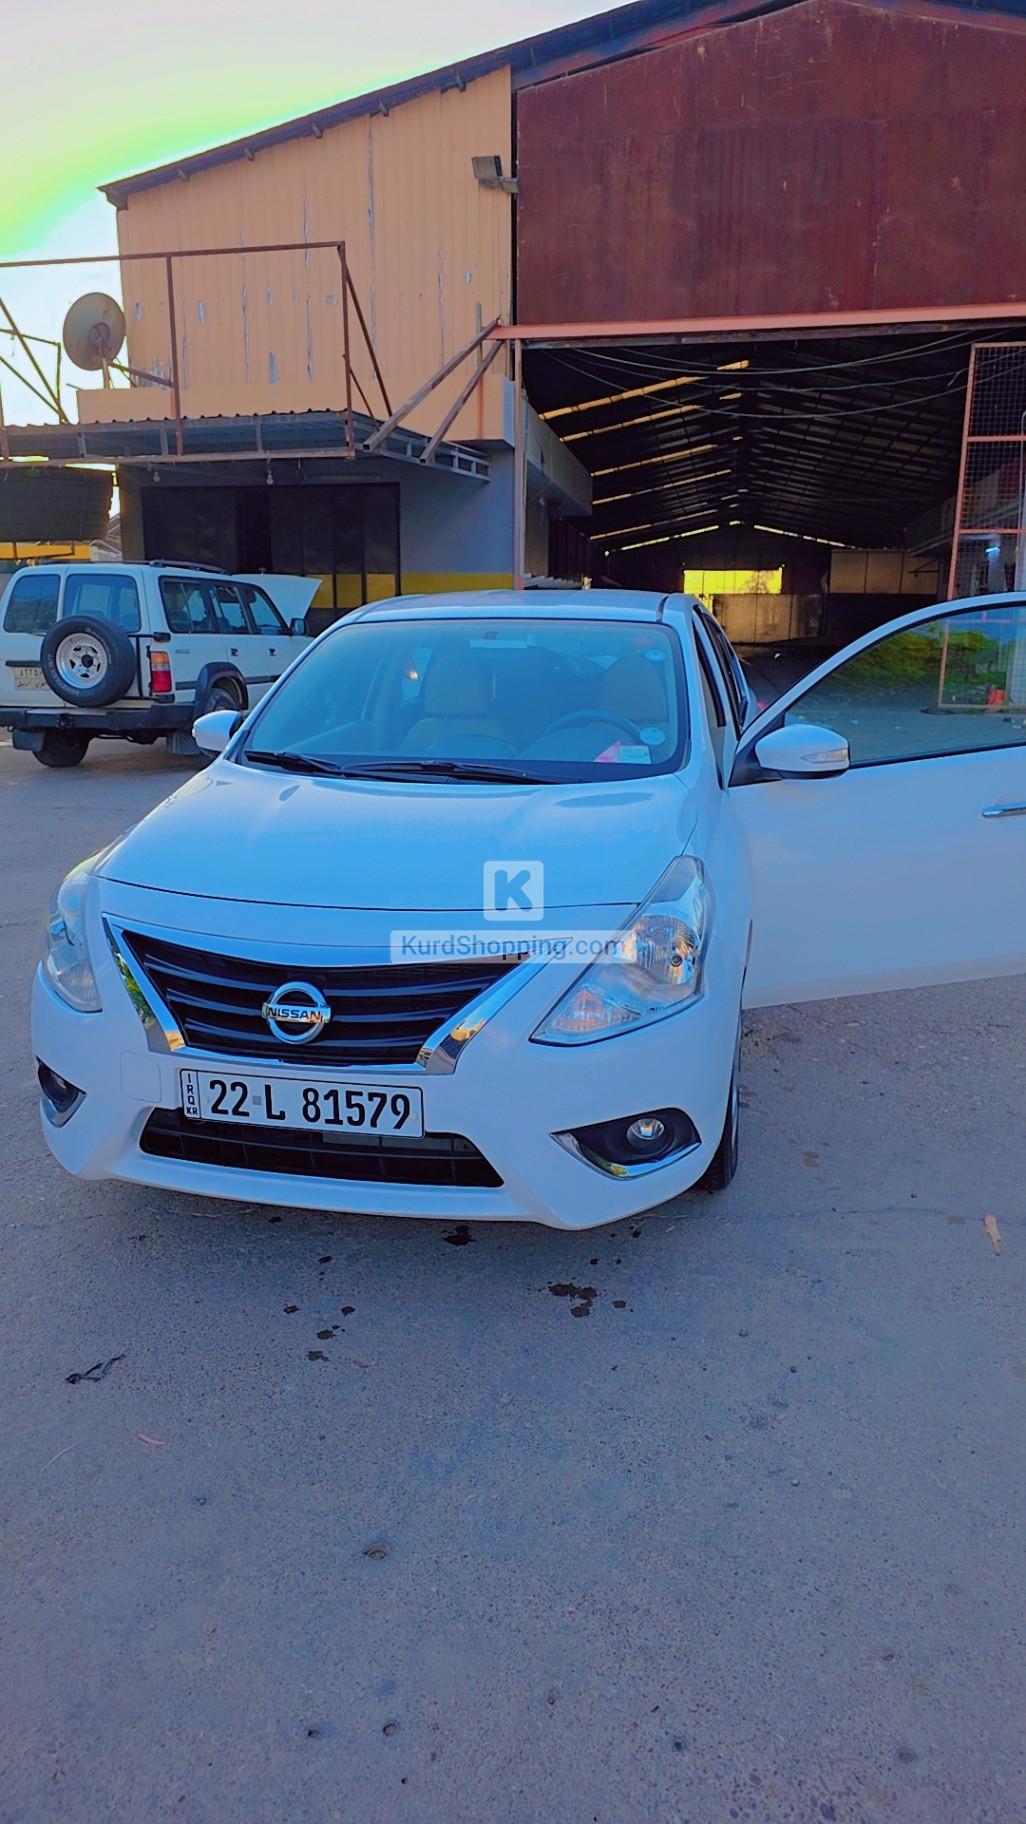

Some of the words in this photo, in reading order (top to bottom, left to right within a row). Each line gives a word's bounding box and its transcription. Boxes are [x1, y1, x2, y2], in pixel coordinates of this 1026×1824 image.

[268, 1007, 321, 1020] NISSAN
[209, 1079, 250, 1118] 22
[264, 1083, 286, 1121] L
[302, 1087, 411, 1130] 81579
